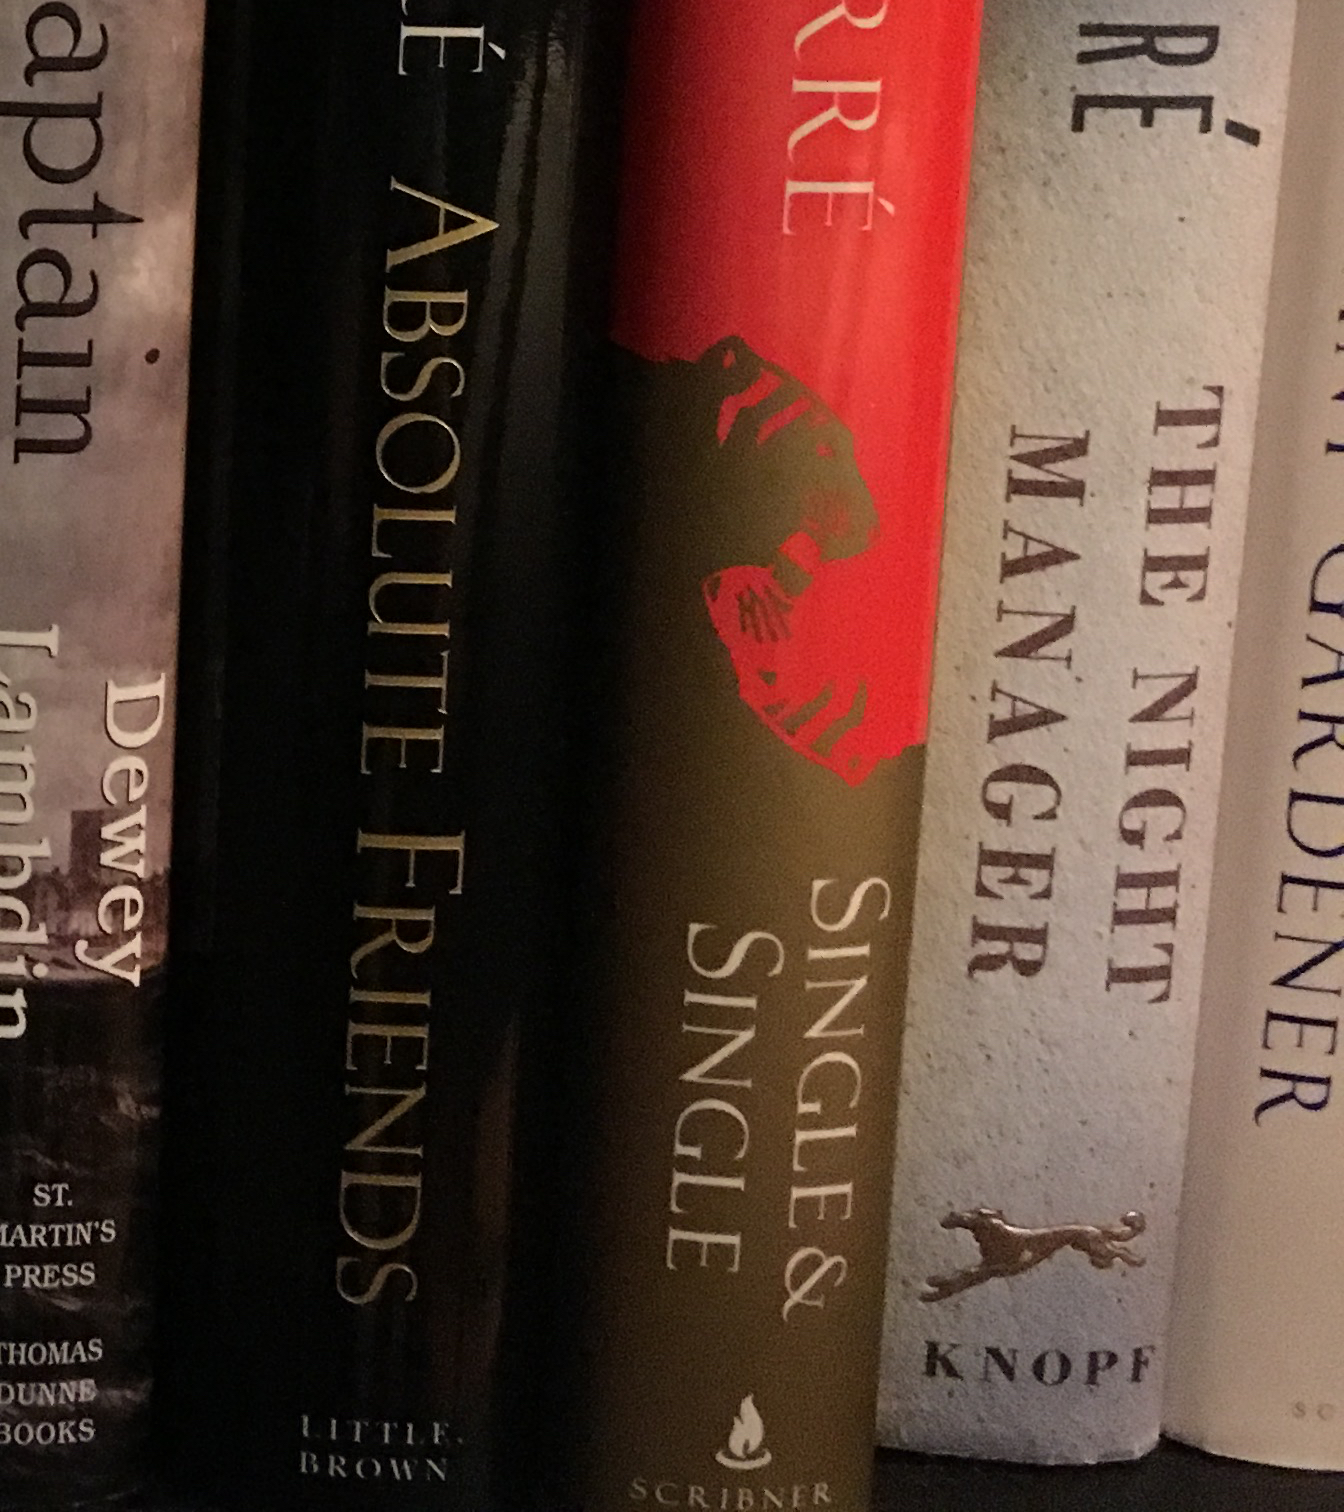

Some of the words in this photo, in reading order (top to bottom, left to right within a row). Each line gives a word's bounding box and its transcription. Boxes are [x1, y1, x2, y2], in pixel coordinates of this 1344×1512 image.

[359, 174, 501, 776] ABSOLUTE
[1138, 384, 1225, 608] THE
[75, 671, 167, 988] Dewey
[966, 423, 1092, 981] MANAGER
[1104, 666, 1201, 1006] NIGHT
[335, 827, 466, 1308] FRIENDS
[665, 922, 787, 1274] SINGLE
[788, 876, 892, 1230] SINGLE
[3, 1261, 97, 1289] PRESS
[32, 1183, 74, 1208] ST.
[781, 1246, 848, 1323] &
[299, 1450, 448, 1482] BROWN
[629, 1475, 832, 1512] SCRIBNER
[921, 1339, 1159, 1388] KNOPF
